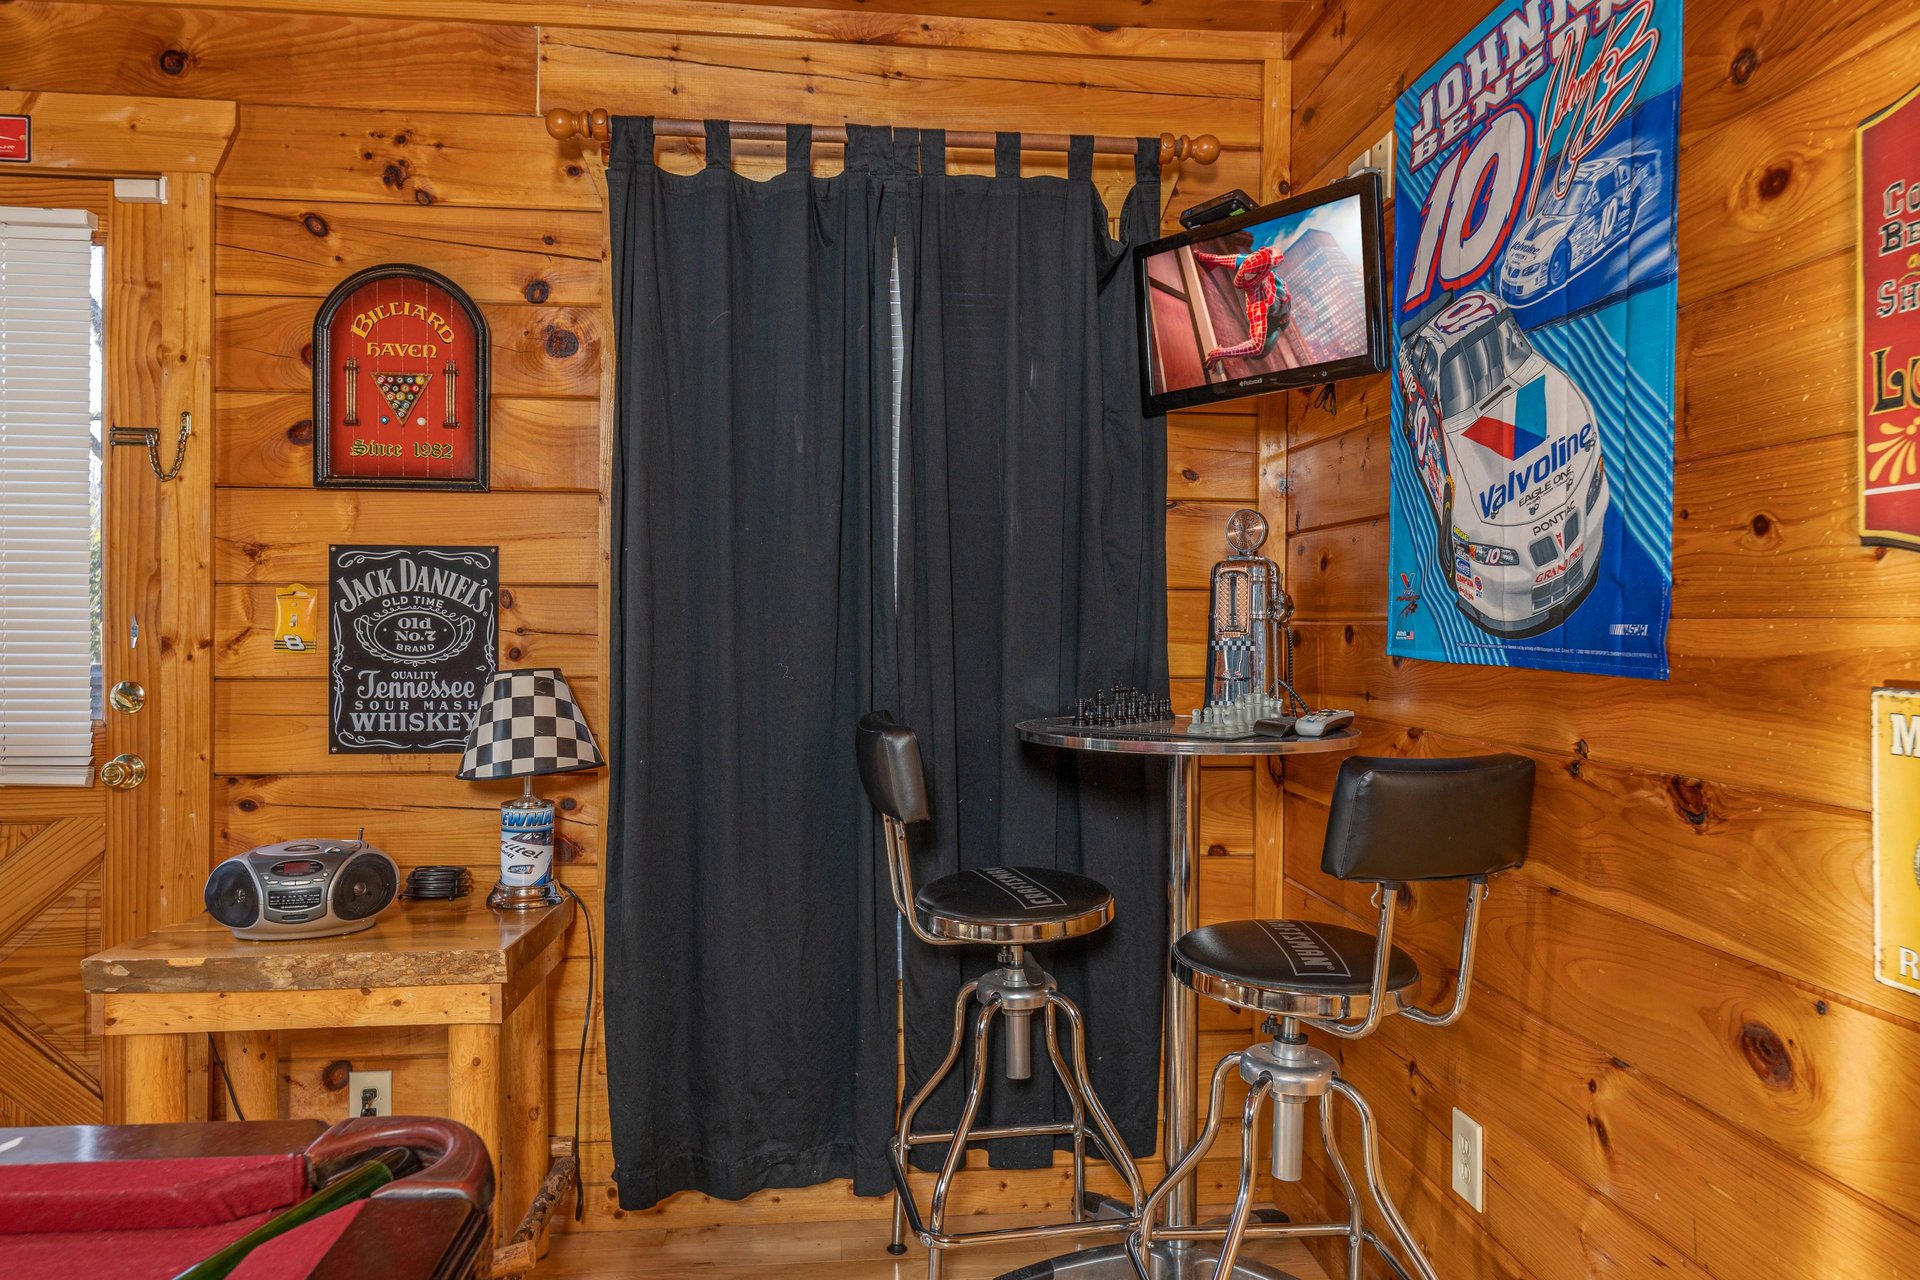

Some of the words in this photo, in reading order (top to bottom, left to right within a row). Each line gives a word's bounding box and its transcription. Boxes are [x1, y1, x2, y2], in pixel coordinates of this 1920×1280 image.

[1404, 108, 1530, 306] 10
[351, 301, 455, 345] BILLIARD
[366, 342, 437, 358] HAVEN
[351, 439, 402, 457] Since
[413, 442, 453, 459] 1982
[1480, 423, 1592, 519] Valvoline
[1519, 480, 1551, 507] EAGLE
[1553, 465, 1573, 485] ONE
[1533, 501, 1575, 536] PONTIAC
[1485, 547, 1500, 564] 10
[1536, 559, 1568, 583] GRAND
[337, 567, 399, 612] JACK
[400, 557, 492, 614] DANIEL'S
[382, 596, 408, 608] OLD
[413, 595, 444, 609] TIME
[398, 617, 432, 630] Old
[396, 643, 435, 653] BRAND
[357, 670, 475, 699] Tennessee
[391, 671, 438, 680] QUALITY
[355, 701, 409, 710] SOUR
[424, 701, 479, 711] MASH
[350, 712, 477, 732] WHISKEY
